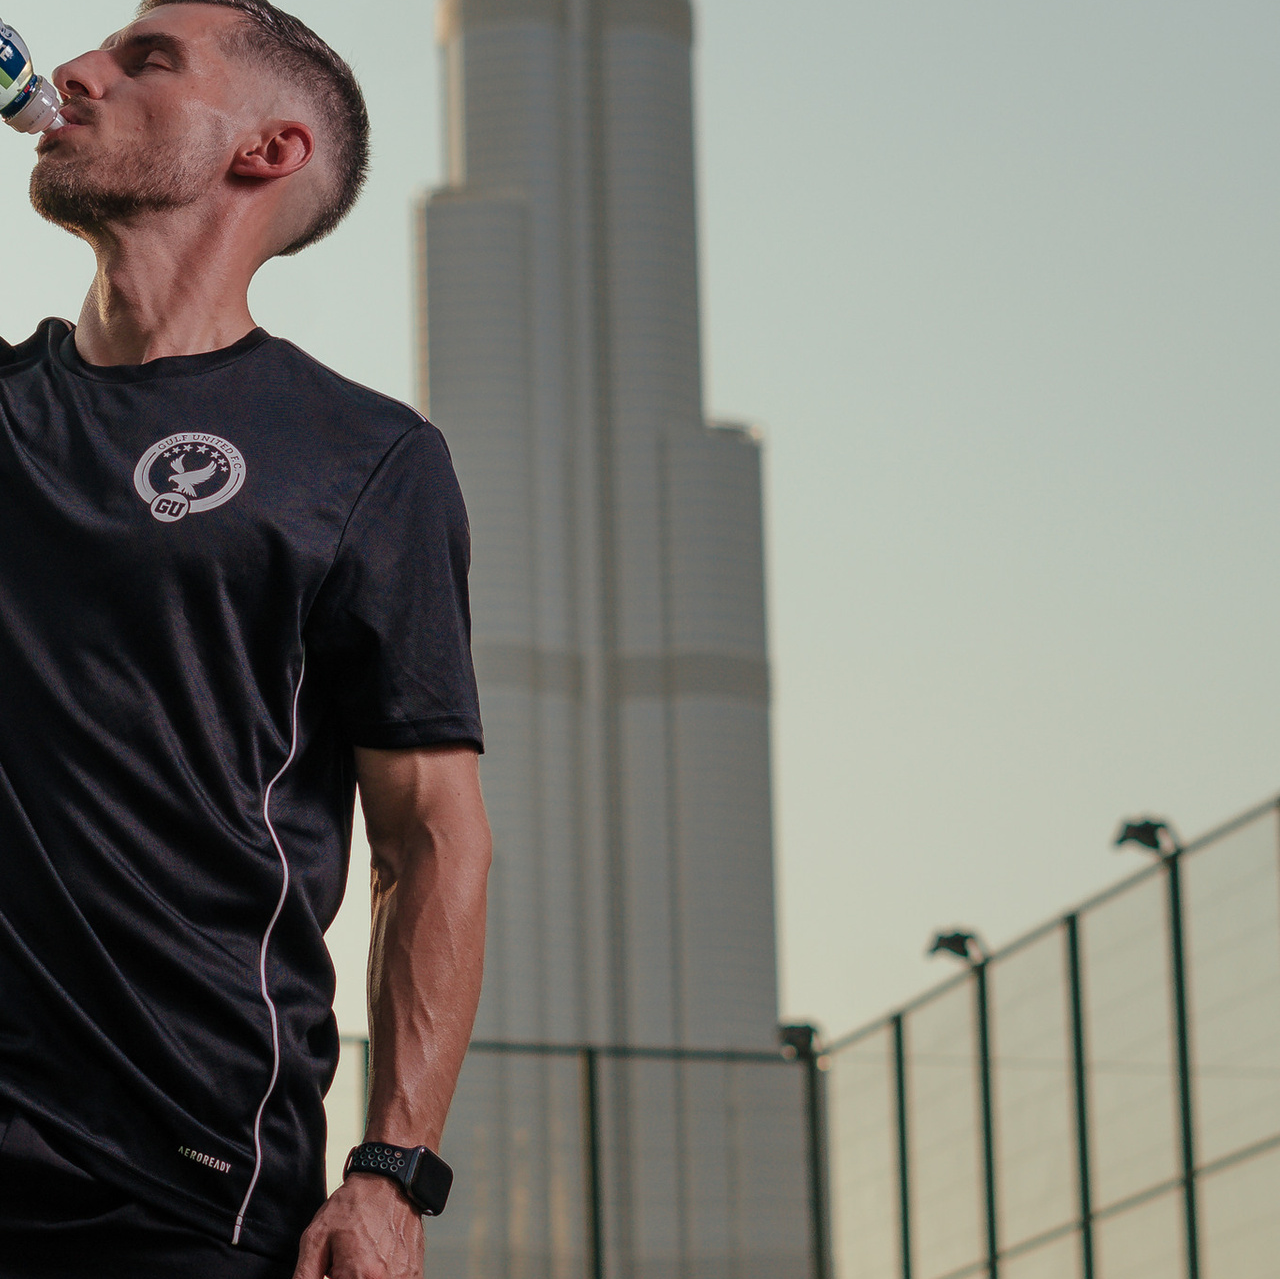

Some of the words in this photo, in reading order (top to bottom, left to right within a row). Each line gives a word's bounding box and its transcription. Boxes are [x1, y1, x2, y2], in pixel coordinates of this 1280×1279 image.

[157, 434, 189, 450] GULF
[192, 434, 234, 455] UNITED
[230, 455, 242, 472] F.C.
[154, 498, 186, 518] GU
[177, 1145, 232, 1174] AEROREADY
